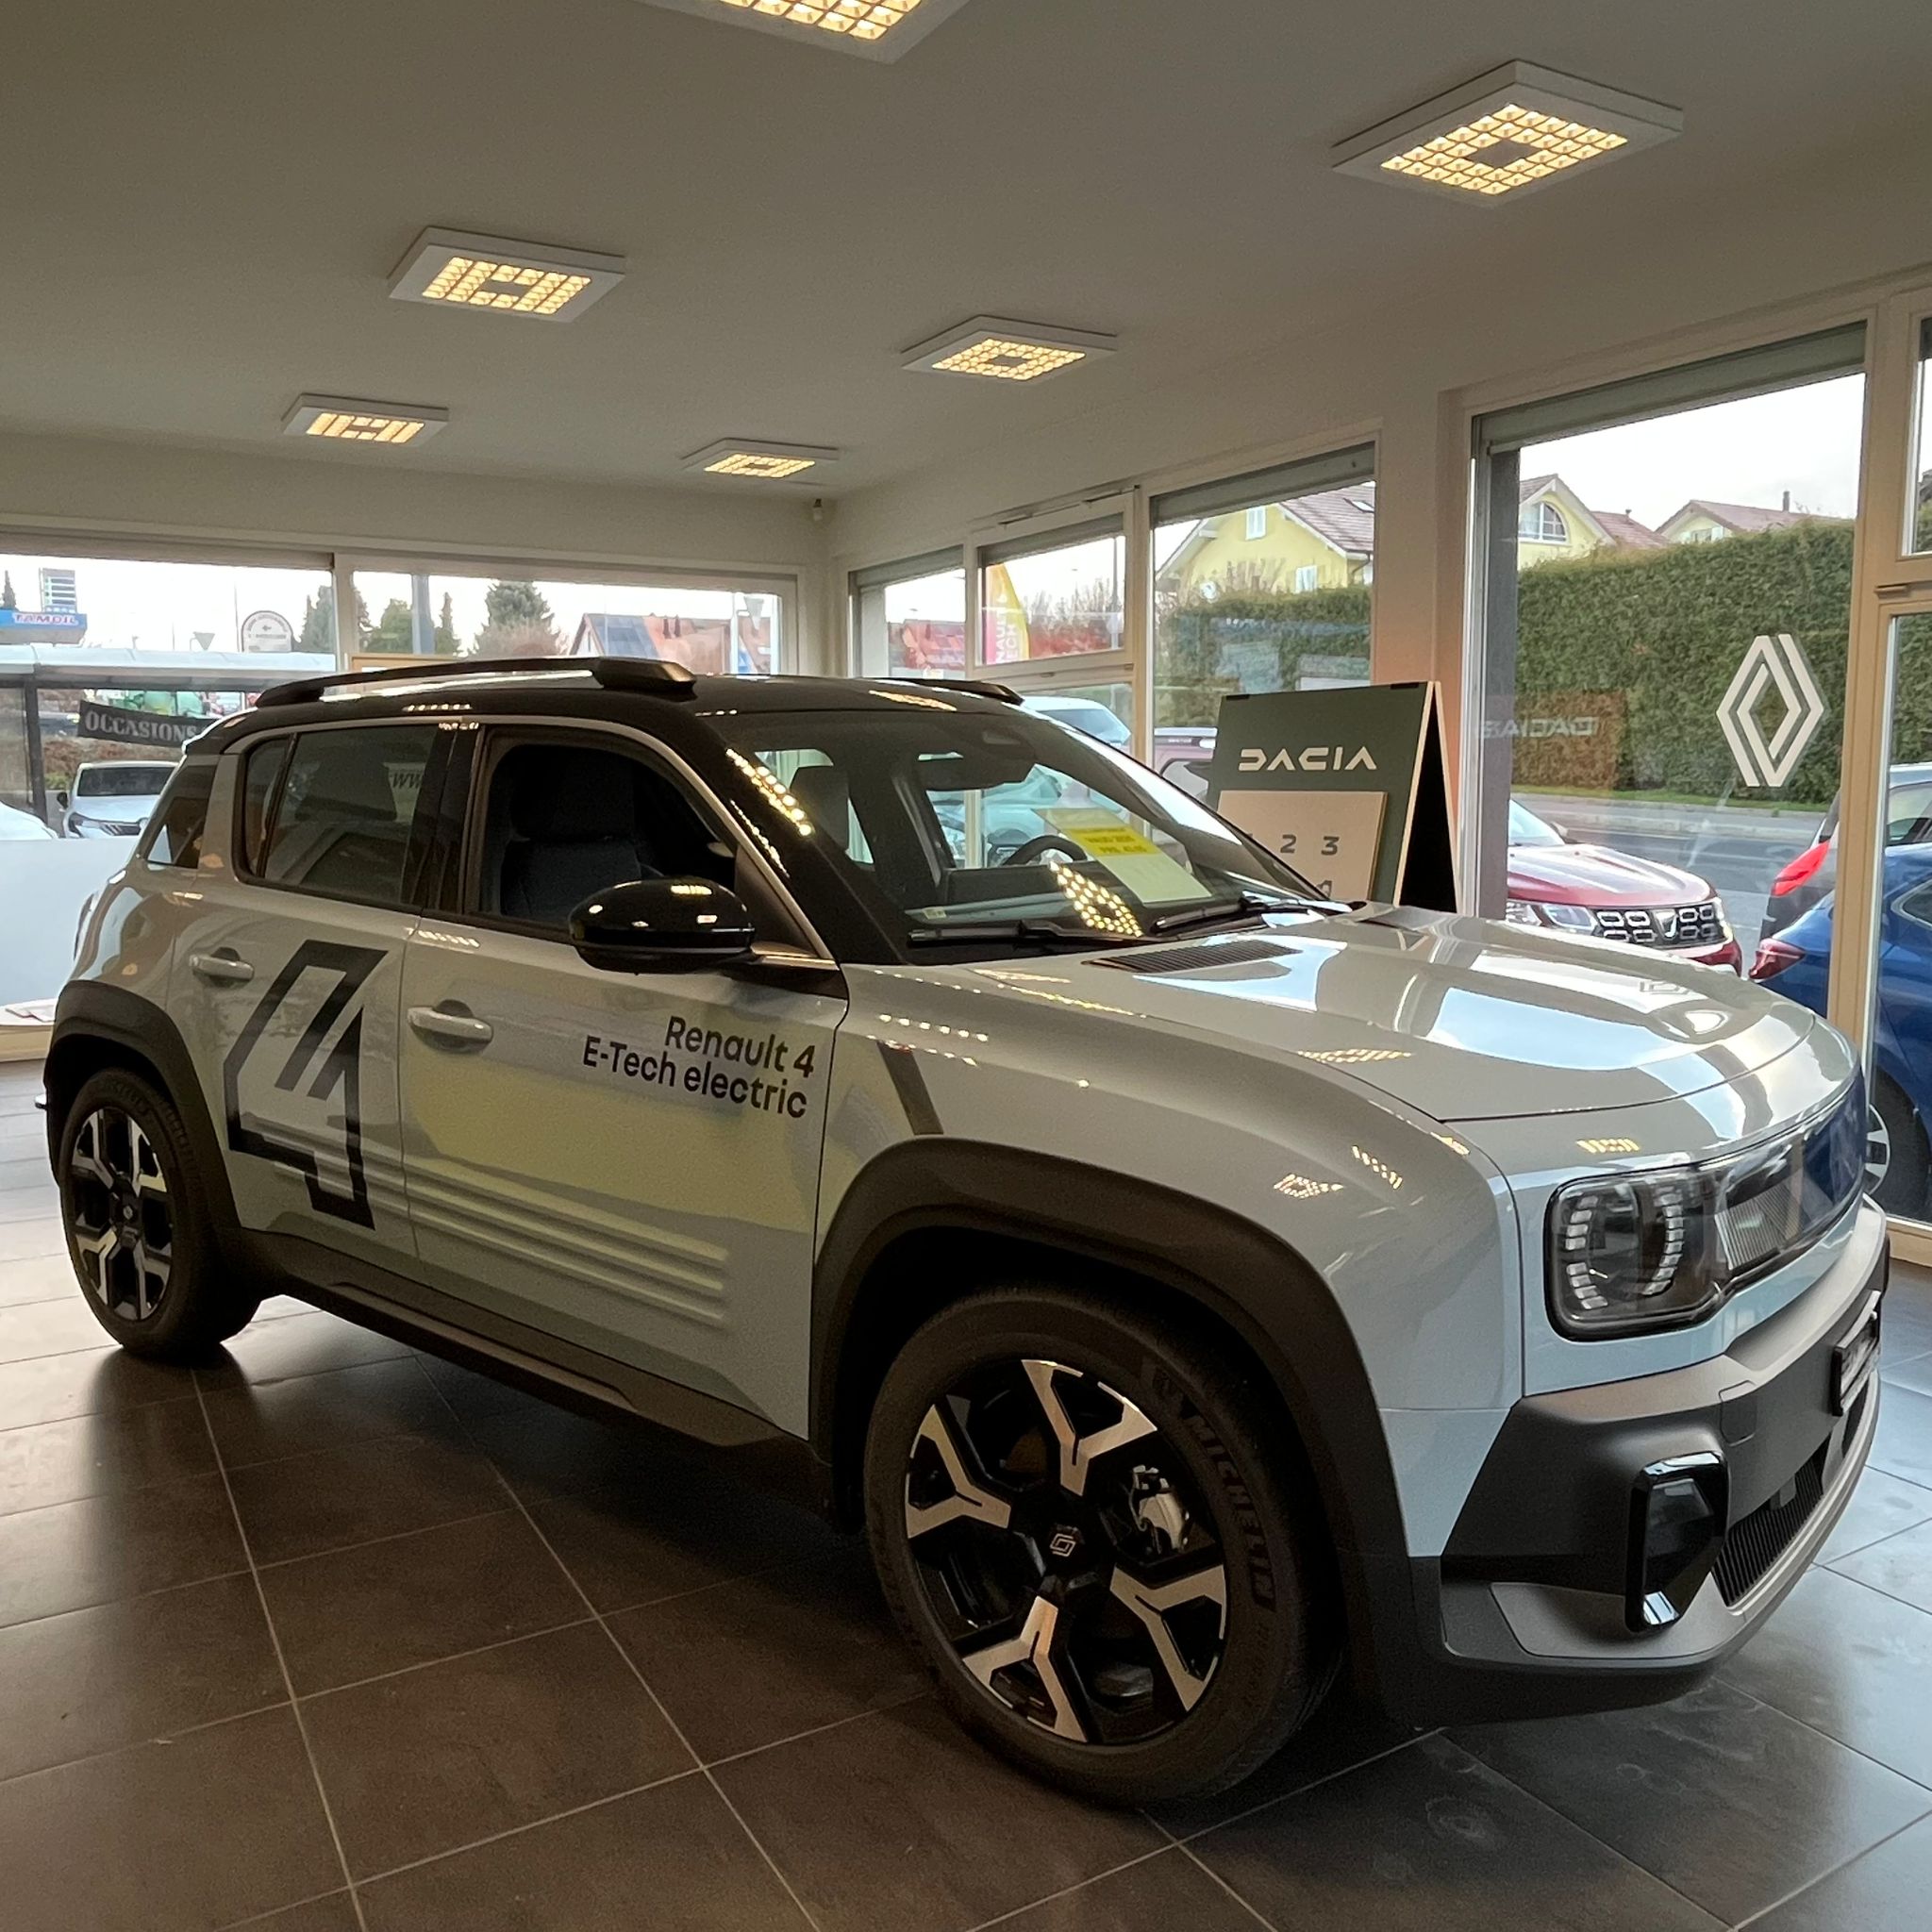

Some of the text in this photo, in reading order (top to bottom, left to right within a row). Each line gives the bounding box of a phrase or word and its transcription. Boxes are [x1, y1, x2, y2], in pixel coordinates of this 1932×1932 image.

[85, 710, 197, 742] OCCASIONS
[1239, 746, 1377, 772] DACIA
[1279, 834, 1340, 857] 2 3
[665, 1015, 816, 1078] Renault 4
[583, 1035, 808, 1118] E-Tech electric
